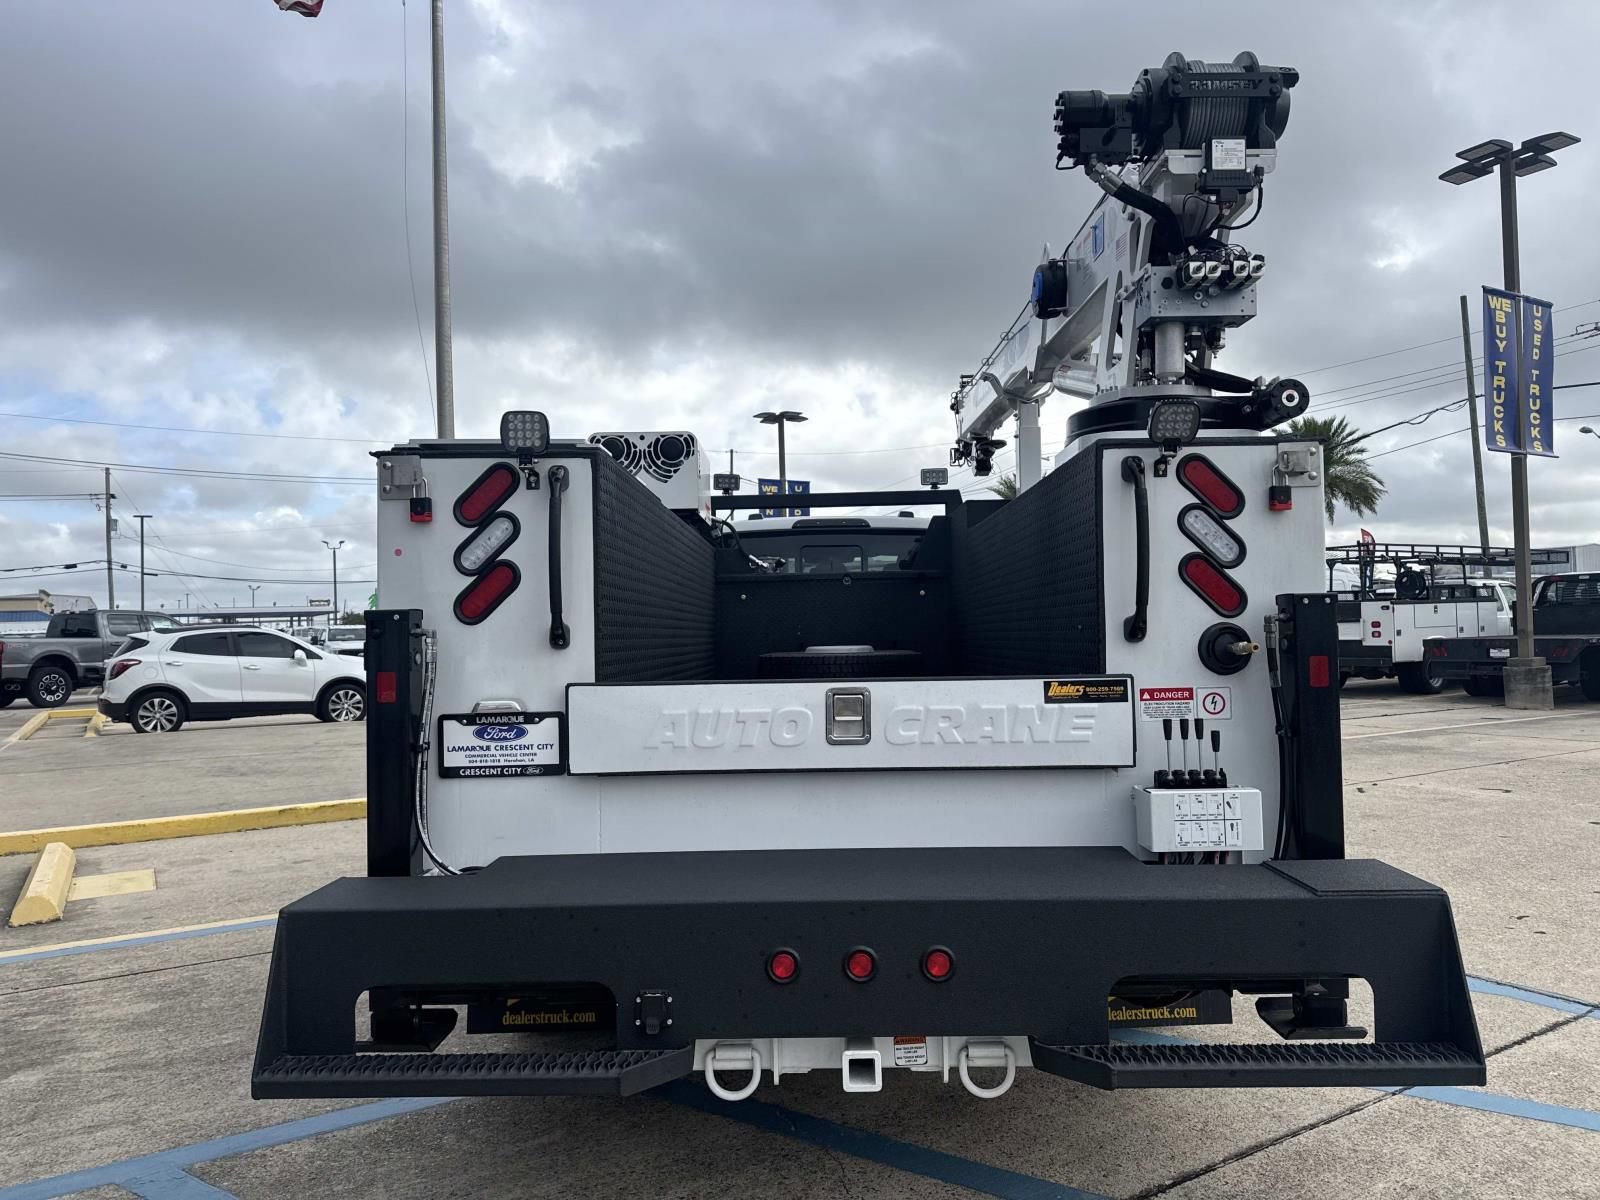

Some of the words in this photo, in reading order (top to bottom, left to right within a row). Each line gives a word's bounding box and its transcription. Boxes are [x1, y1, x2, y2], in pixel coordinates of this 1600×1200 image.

[1488, 295, 1512, 312] WE
[1495, 311, 1508, 353] BUY
[1532, 305, 1542, 361] USED
[1493, 361, 1507, 447] TRUCKS
[1529, 370, 1543, 452] TRUCKS
[1154, 691, 1190, 699] DANGER
[483, 725, 517, 739] Ford
[645, 706, 814, 750] AUTO
[884, 704, 1098, 746] CRANE
[447, 745, 491, 753] LAMARQUE
[494, 744, 534, 752] CRESCENT
[536, 743, 554, 751] CITY
[459, 768, 501, 776] CRESCENT
[504, 767, 521, 775] CITY
[503, 1010, 596, 1025] dealerstruck.com
